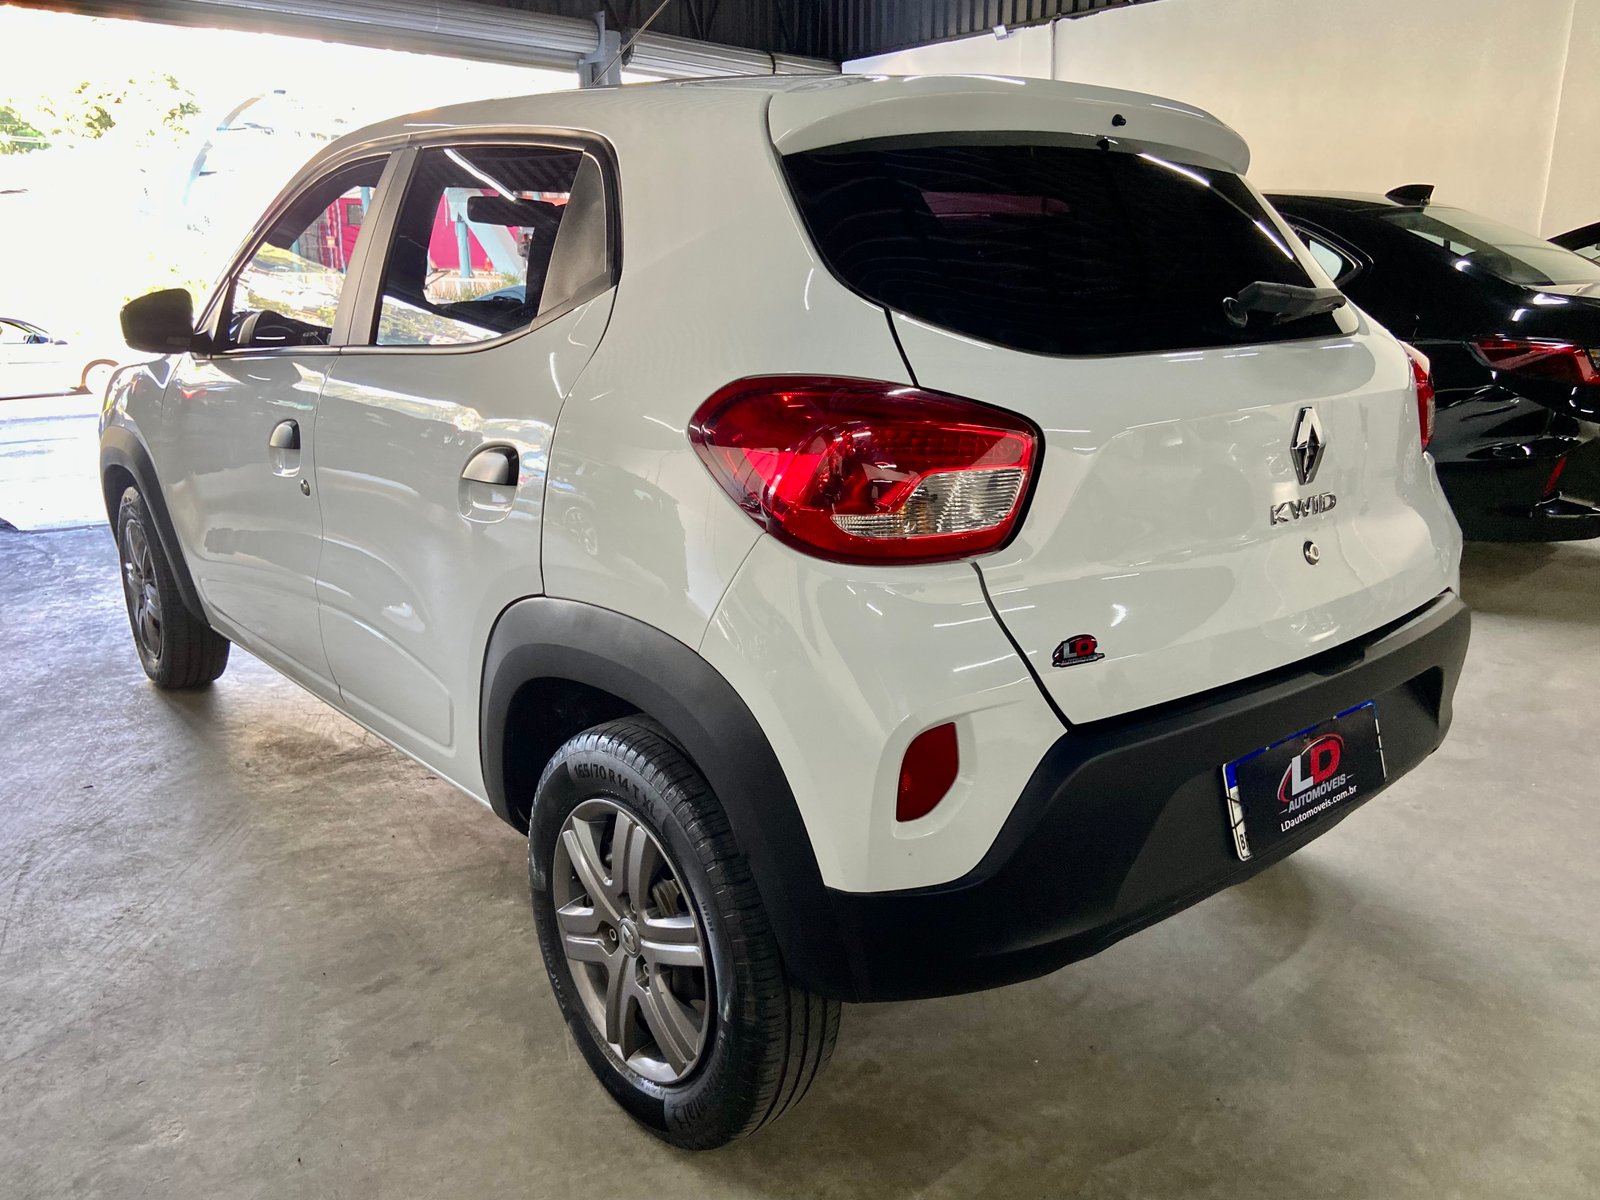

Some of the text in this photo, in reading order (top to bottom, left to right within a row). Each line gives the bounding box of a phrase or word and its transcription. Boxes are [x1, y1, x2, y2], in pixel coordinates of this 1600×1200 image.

[1270, 491, 1337, 526] KWID
[1063, 638, 1096, 659] LD
[574, 763, 606, 780] 165/70
[1291, 739, 1341, 796] LD
[1280, 785, 1357, 833] LDautomoveis.com.br
[1288, 773, 1346, 814] AUTOMÓVEIS
